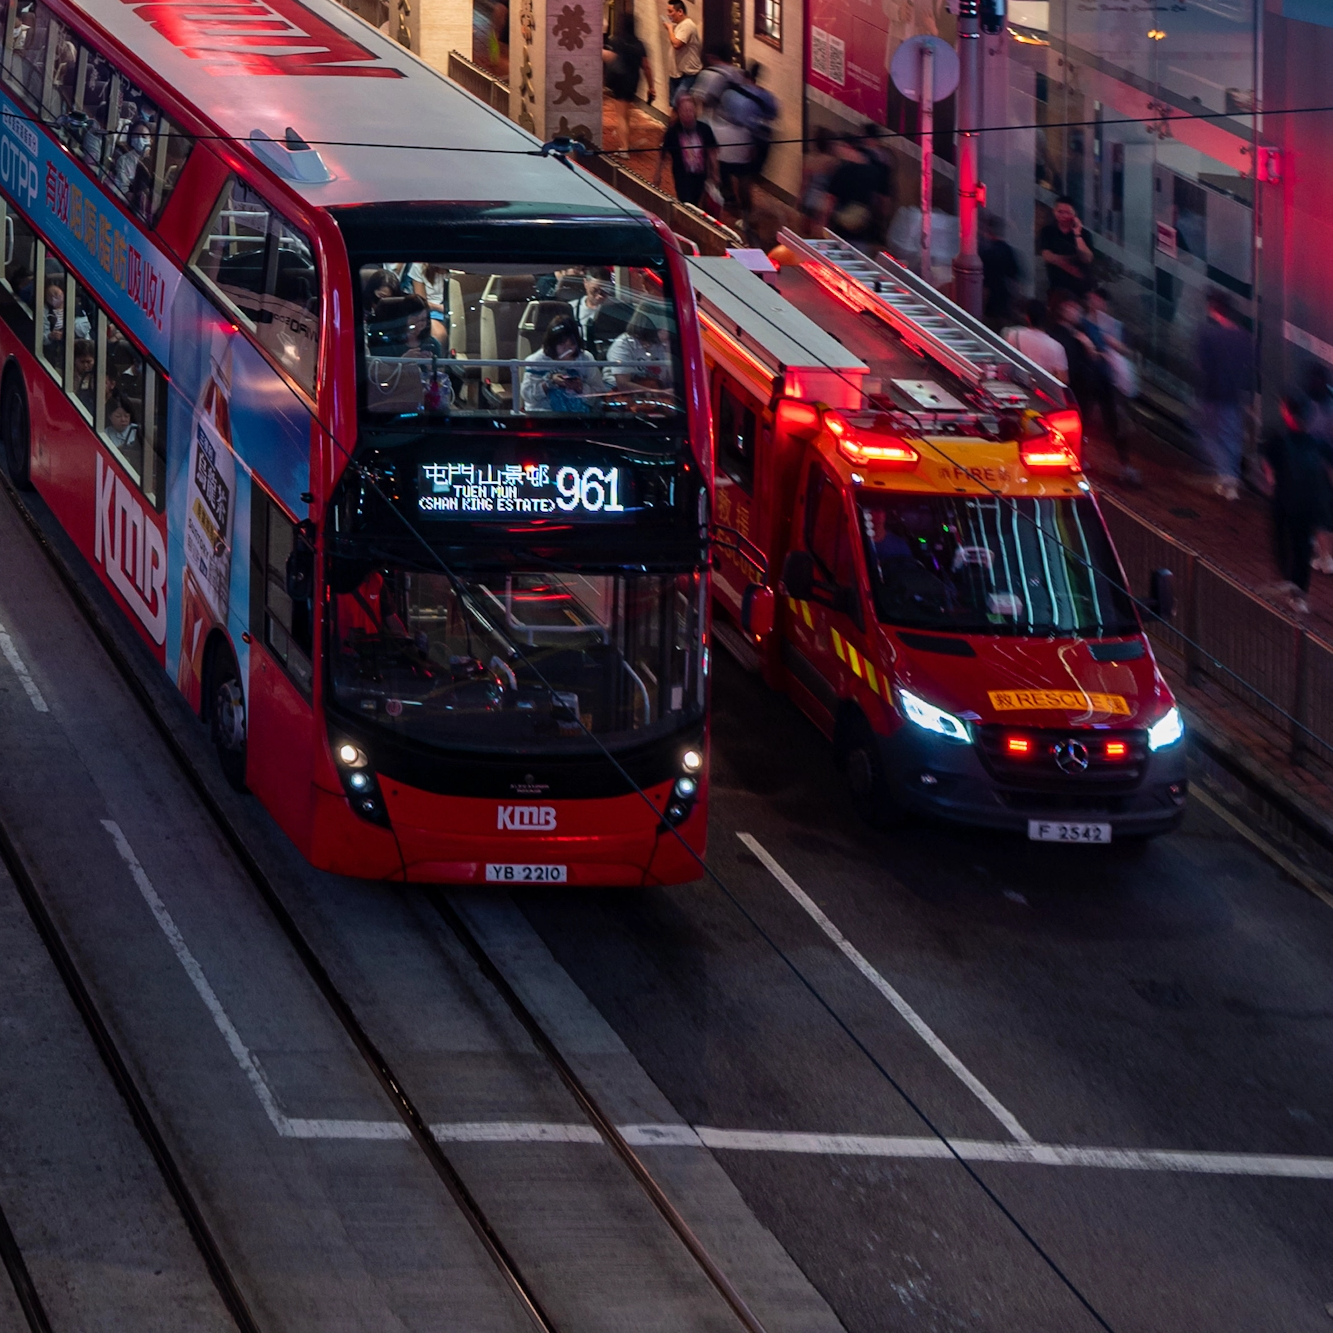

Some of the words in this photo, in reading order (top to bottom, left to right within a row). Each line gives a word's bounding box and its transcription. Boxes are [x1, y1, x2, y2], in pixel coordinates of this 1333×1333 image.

[0, 133, 40, 208] OTPP
[422, 461, 550, 488] 屯門山景邨
[953, 467, 996, 482] FIRE
[196, 451, 228, 525] 烏龍茶
[452, 484, 489, 499] TUEN
[490, 484, 519, 499] MUN
[555, 466, 625, 513] 961
[462, 496, 495, 512] KING
[93, 452, 168, 646] KMB
[994, 693, 1016, 710] 救
[1016, 692, 1105, 710] RESCUE
[496, 804, 558, 831] KMB
[1038, 824, 1051, 838] F
[1058, 826, 1103, 842] 2542
[492, 865, 515, 880] YB
[522, 866, 561, 881] 2210
